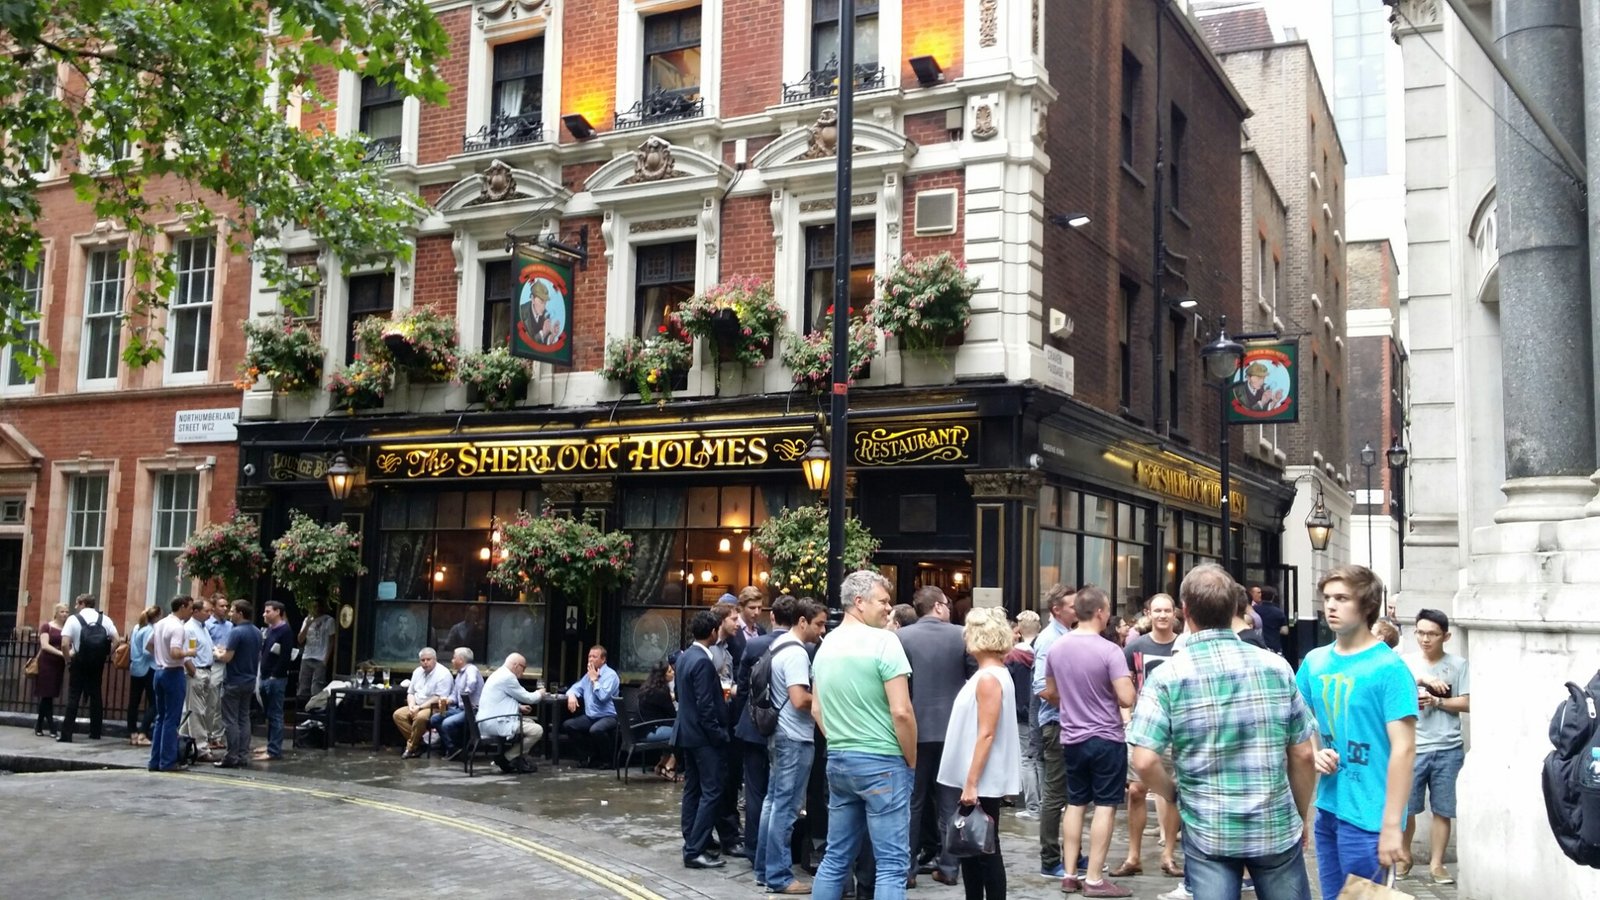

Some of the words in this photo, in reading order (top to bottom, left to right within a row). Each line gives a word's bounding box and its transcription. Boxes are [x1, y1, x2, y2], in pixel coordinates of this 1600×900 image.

[178, 423, 200, 432] STREET
[201, 422, 215, 431] WC2
[179, 411, 236, 422] NORTHUMBERLAND
[406, 449, 455, 477] The
[456, 443, 620, 477] SHERLOCK
[628, 437, 769, 471] HOLMES
[859, 426, 963, 461] RESTAURANT
[273, 452, 313, 474] LOUNGE
[1160, 467, 1207, 503] SHERLOCK
